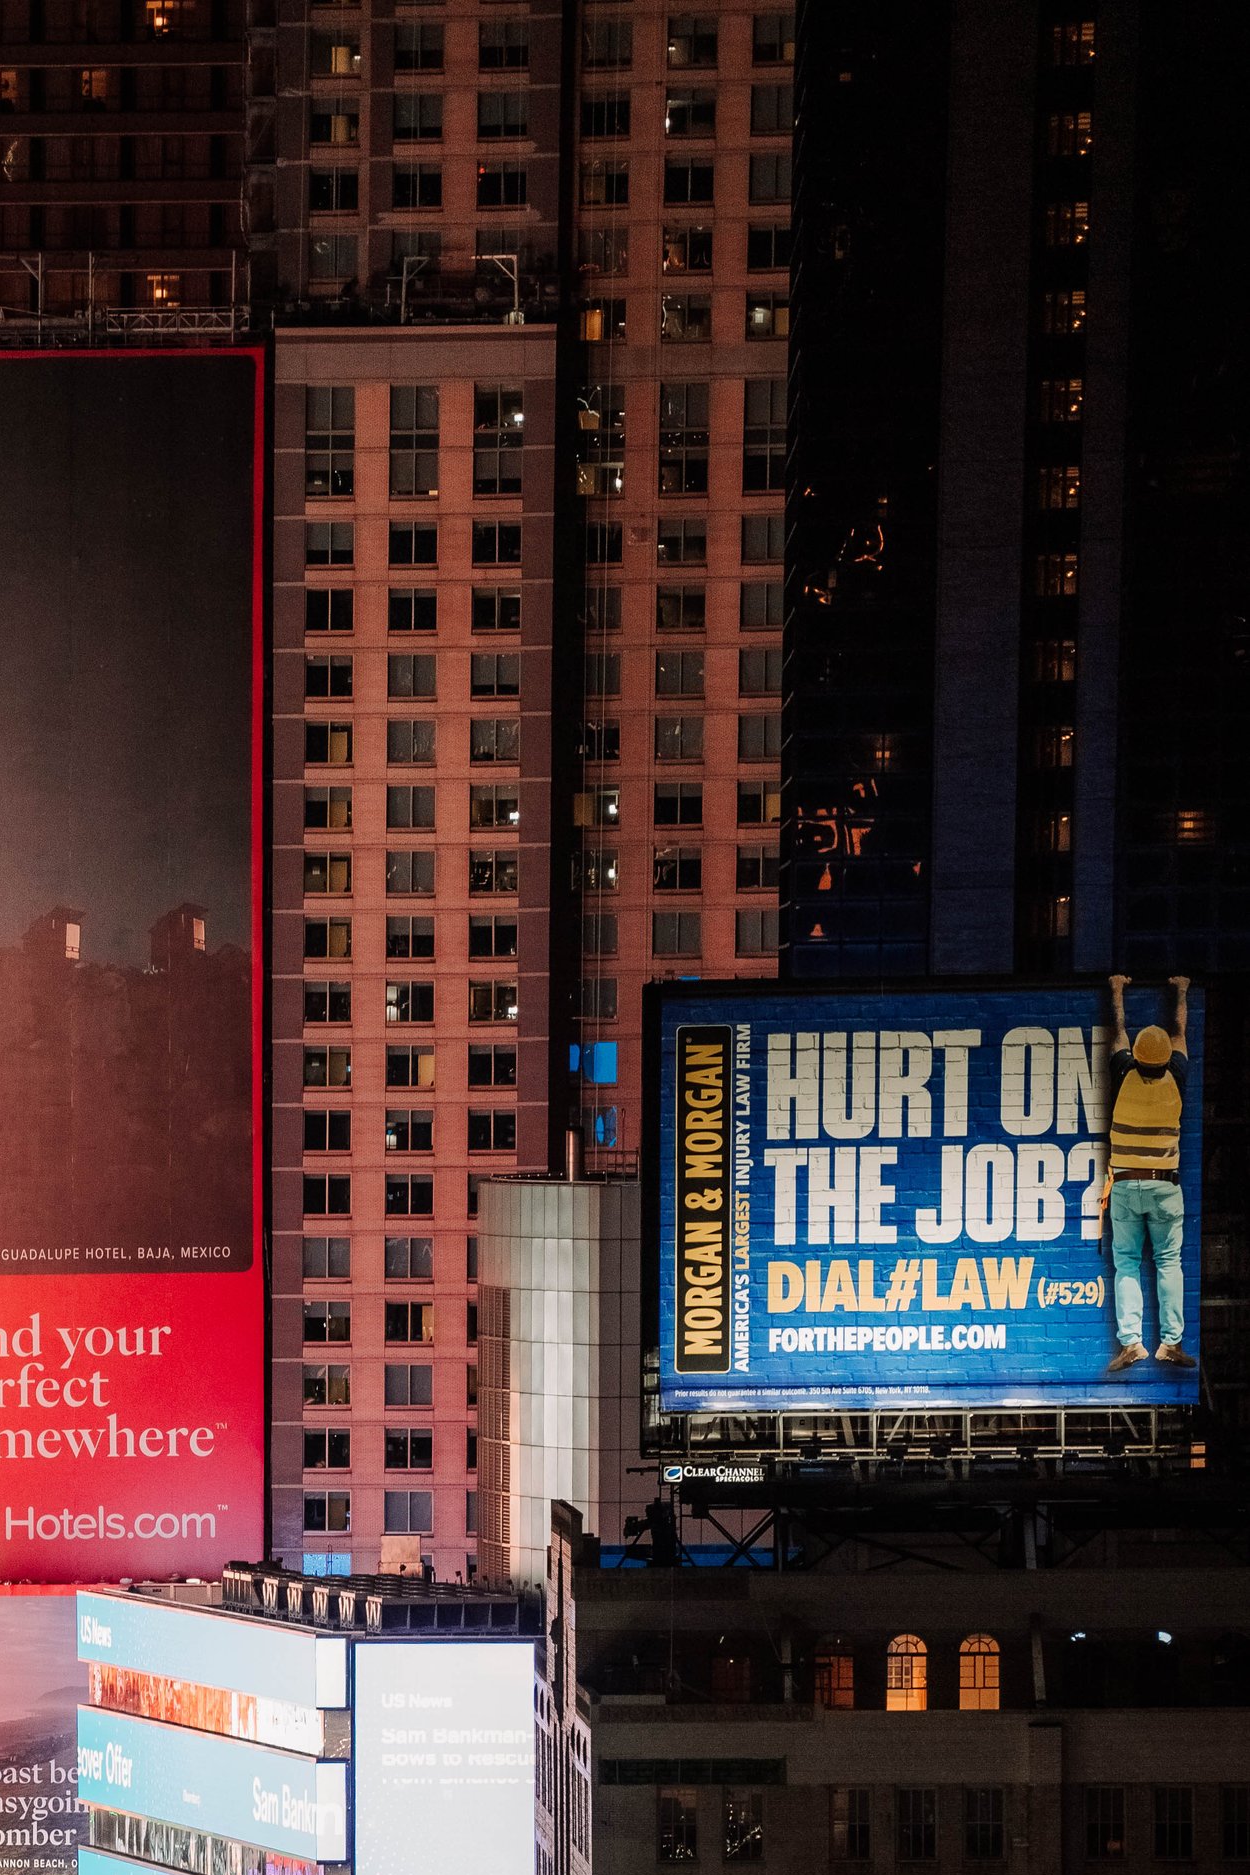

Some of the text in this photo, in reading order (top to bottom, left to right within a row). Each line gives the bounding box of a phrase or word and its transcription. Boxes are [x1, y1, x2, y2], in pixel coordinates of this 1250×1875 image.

[766, 1025, 1109, 1141] HURT ON
[684, 1043, 724, 1356] MORGAN & MORGAN
[734, 1024, 751, 1373] AMERICA'S LARGEST INJURY LAW FIRM
[763, 1140, 1110, 1246] THE JOB?
[0, 1247, 80, 1261] GUADALUPE
[85, 1247, 132, 1260] HOTEL,
[137, 1246, 175, 1260] BAJA,
[180, 1246, 232, 1259] MEXICO
[766, 1257, 1106, 1314] DIAL#LAW (#529)
[55, 1325, 172, 1370] your
[768, 1324, 1007, 1353] FORTHEPEOPLE.COM
[689, 1389, 708, 1397] results
[727, 1388, 756, 1398] guarantee
[761, 1387, 781, 1396] similar
[80, 1615, 112, 1648] US News
[382, 1693, 406, 1709] US
[381, 1728, 427, 1745] Sam
[105, 1742, 133, 1788] Offer
[252, 1776, 278, 1825] Sam
[33, 1858, 68, 1870] BEACH,
